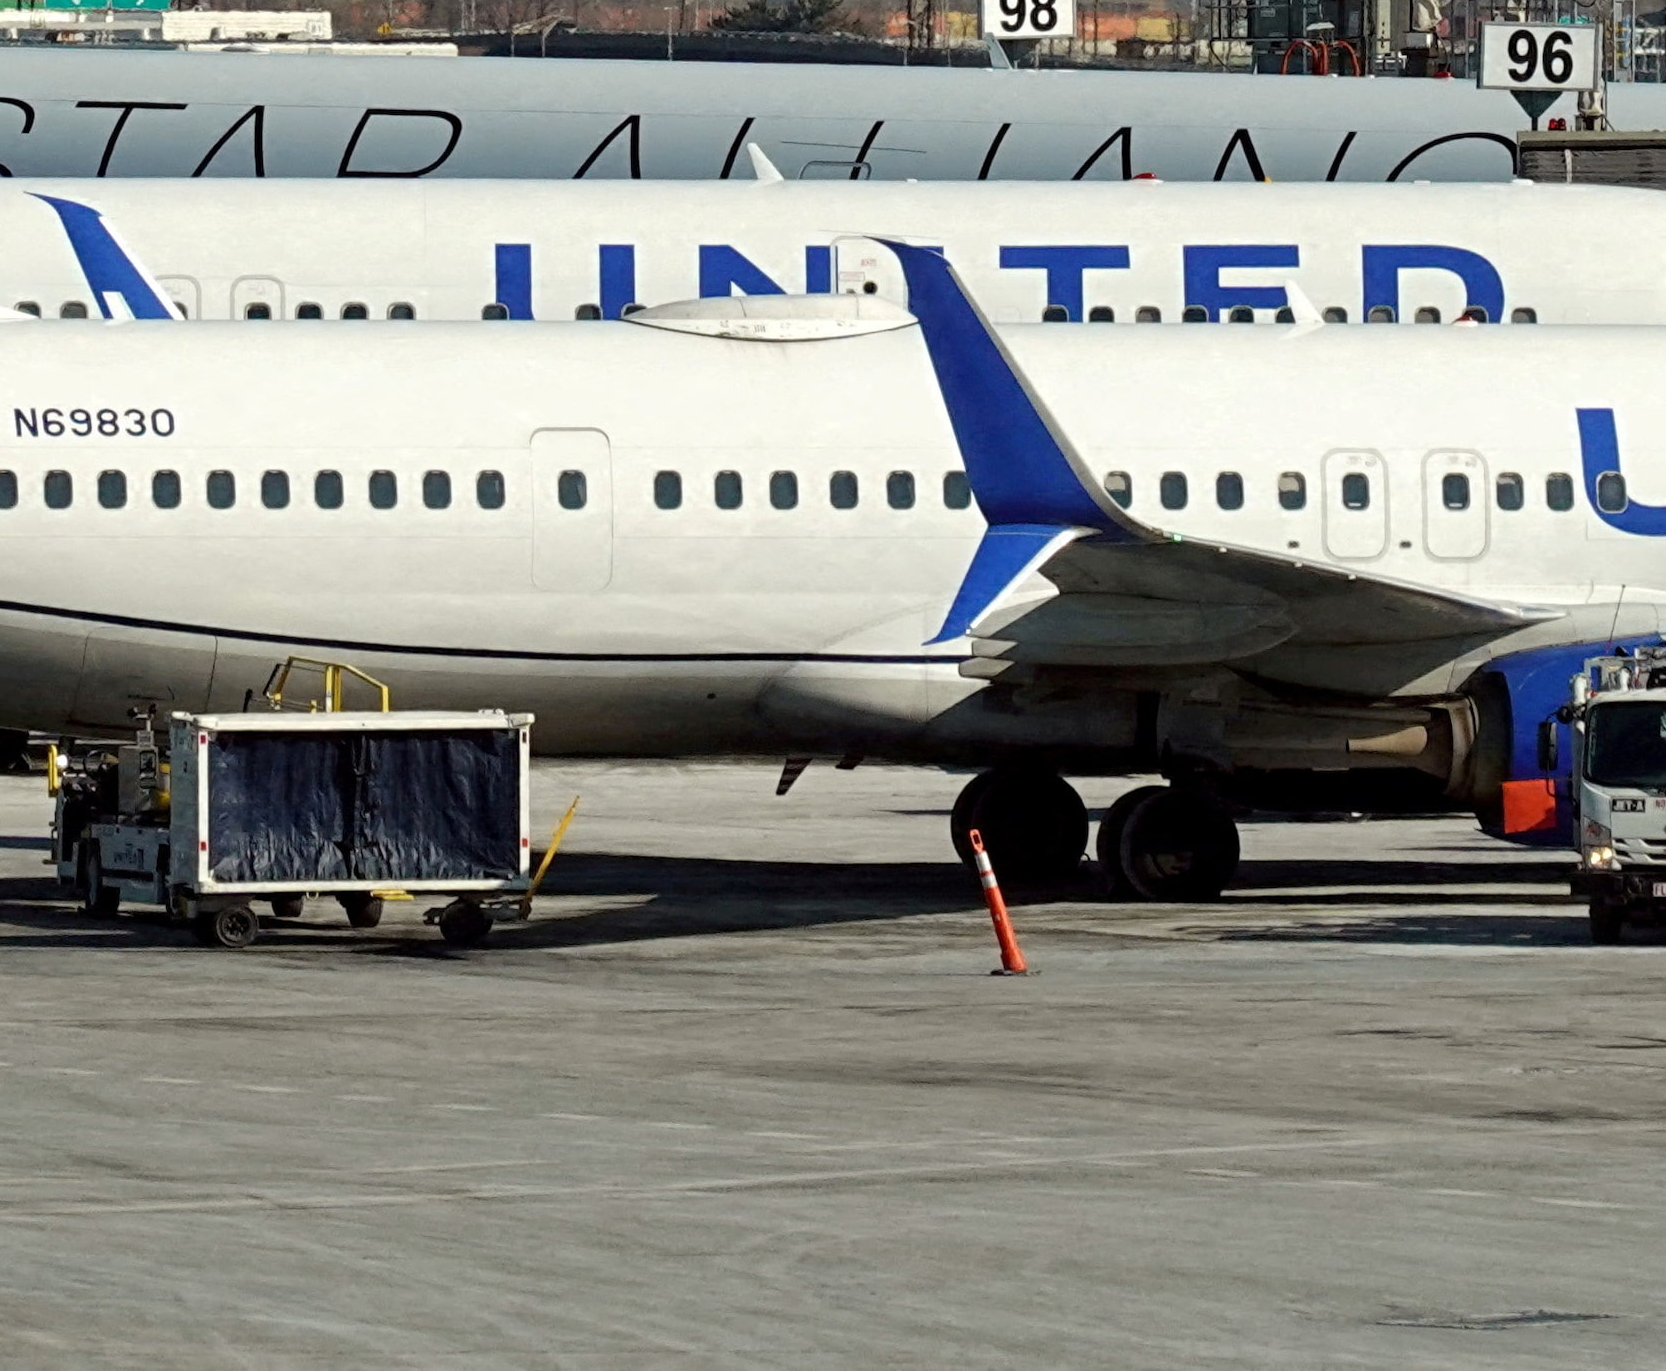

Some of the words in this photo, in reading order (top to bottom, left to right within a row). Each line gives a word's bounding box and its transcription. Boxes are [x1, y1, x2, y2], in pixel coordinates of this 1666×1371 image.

[1508, 29, 1573, 84] 96
[495, 243, 1505, 323] UNTED
[14, 408, 175, 437] N69830
[1613, 800, 1644, 810] JET-A
[1655, 799, 1666, 808] NO
